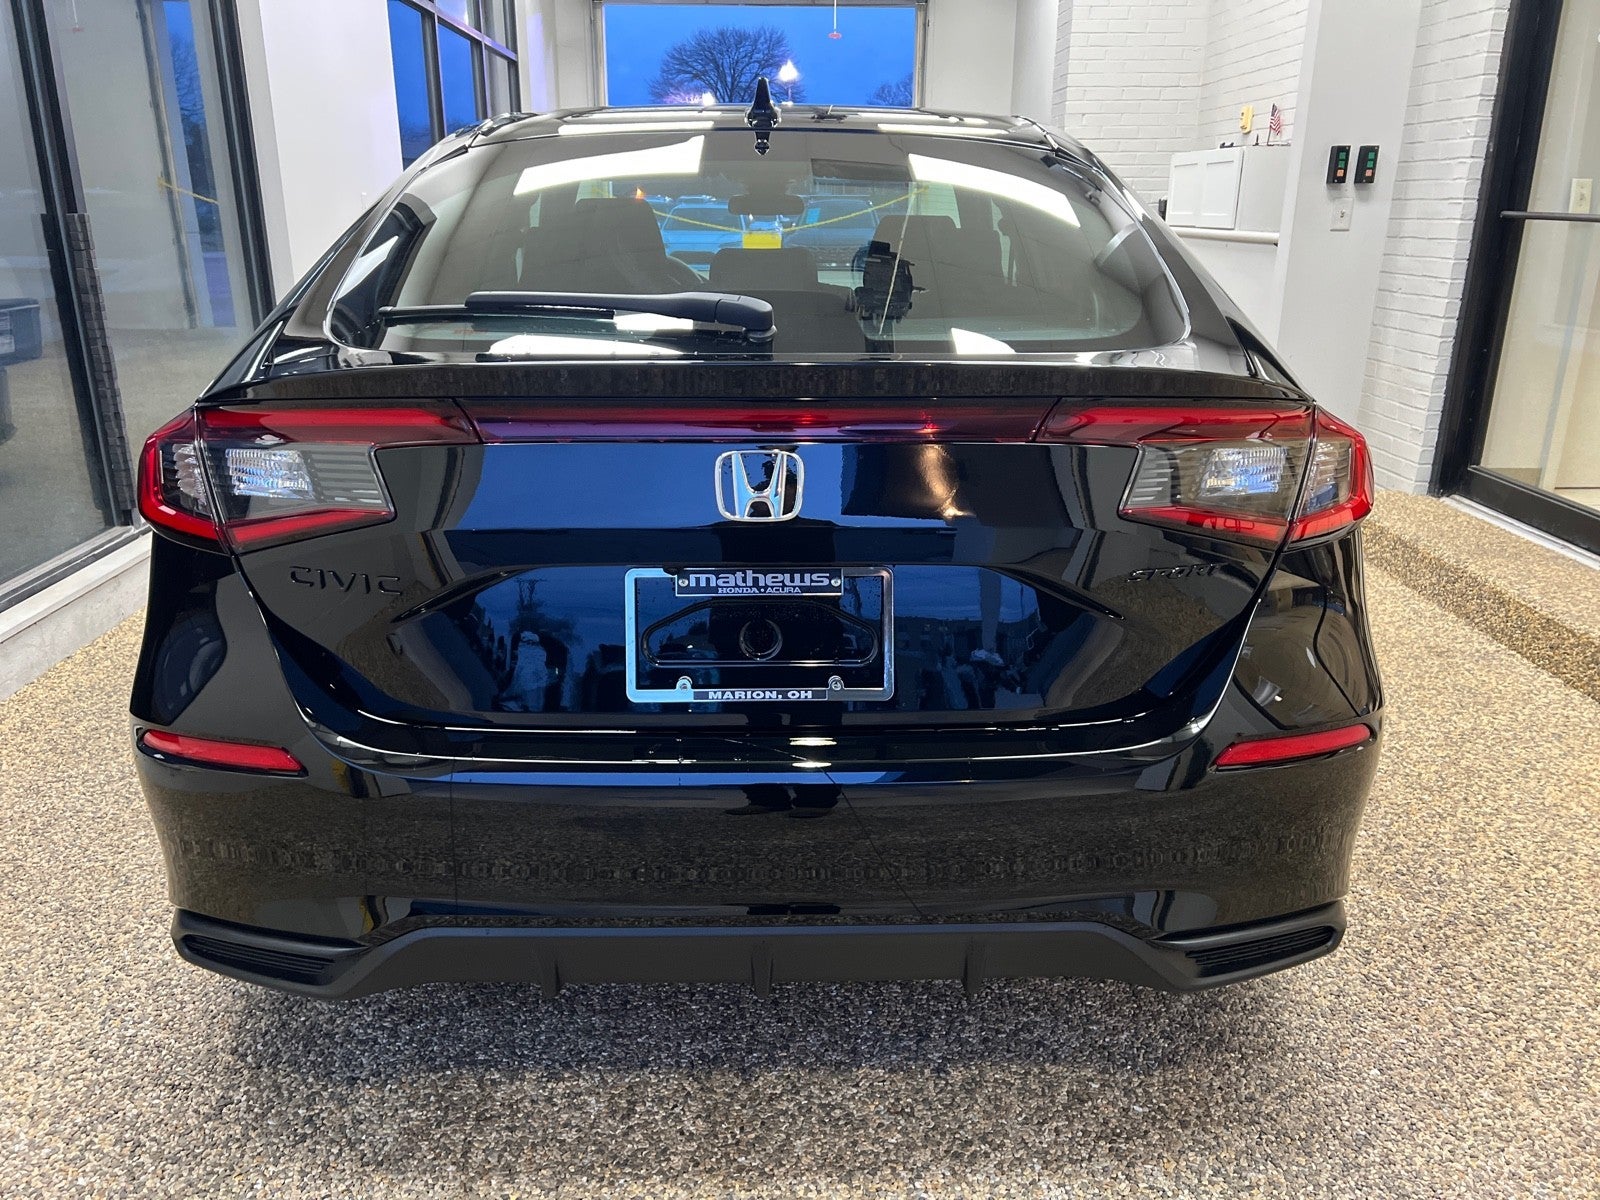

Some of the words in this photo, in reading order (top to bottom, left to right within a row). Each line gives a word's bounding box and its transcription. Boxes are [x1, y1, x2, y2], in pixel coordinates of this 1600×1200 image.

[289, 566, 403, 595] CIVIC
[689, 570, 830, 587] mathews
[708, 690, 783, 700] MARION,
[787, 690, 813, 699] OH
